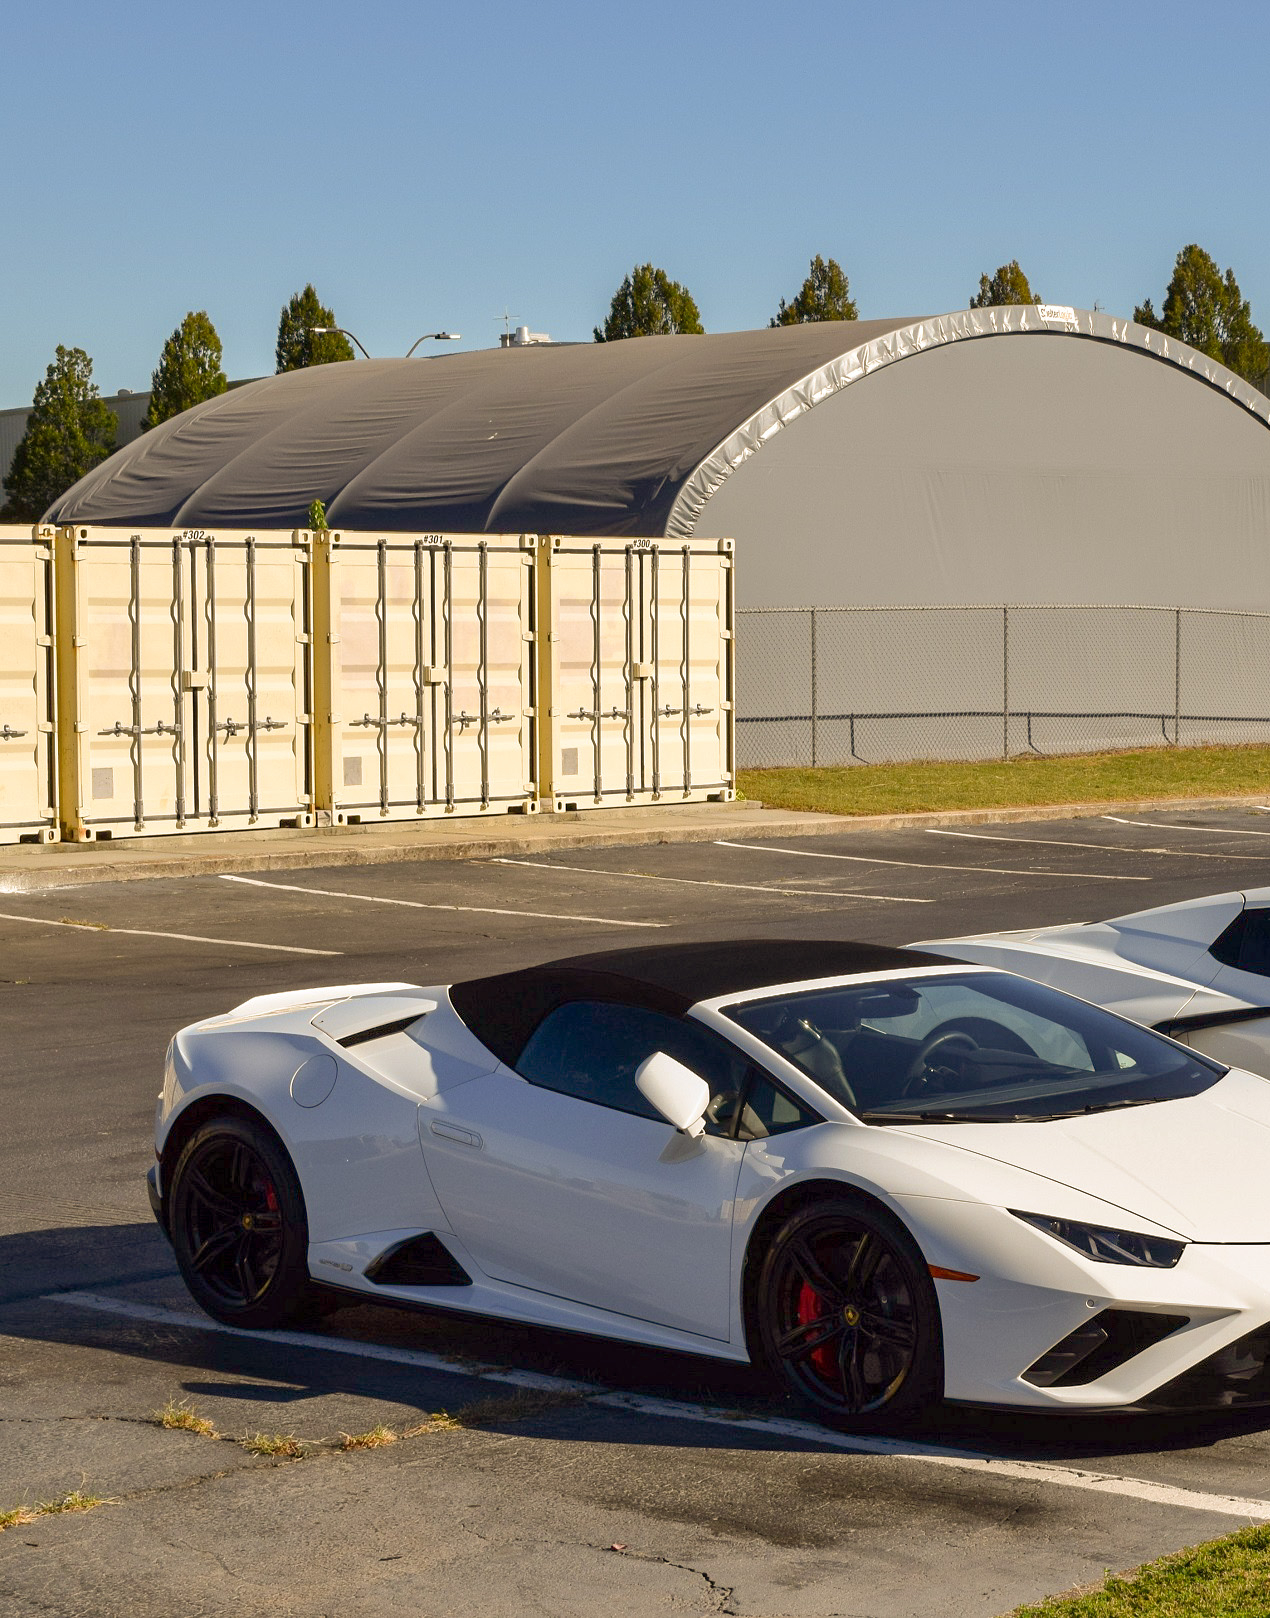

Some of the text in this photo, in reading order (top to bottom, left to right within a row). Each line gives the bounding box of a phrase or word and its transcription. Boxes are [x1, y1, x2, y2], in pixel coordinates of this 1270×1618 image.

[183, 530, 205, 540] #302
[424, 535, 443, 544] #301
[633, 539, 651, 548] #300
